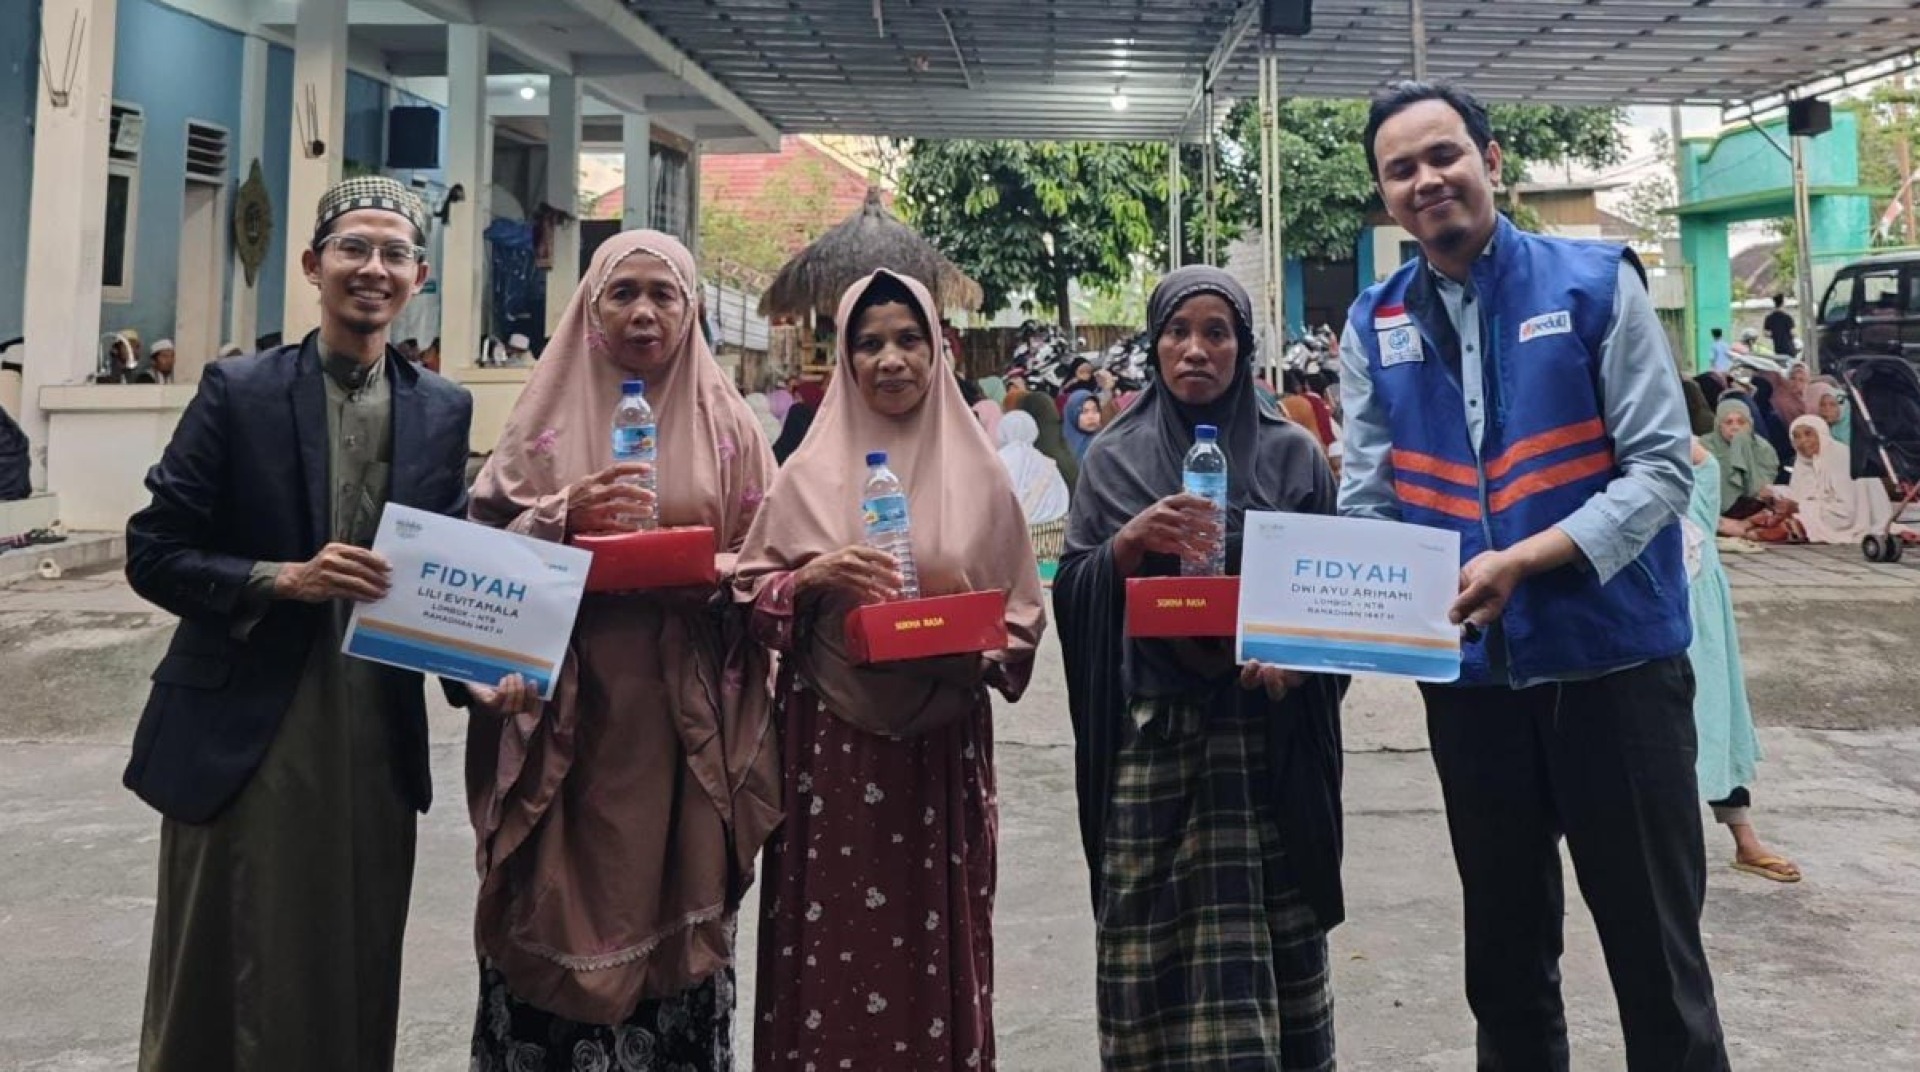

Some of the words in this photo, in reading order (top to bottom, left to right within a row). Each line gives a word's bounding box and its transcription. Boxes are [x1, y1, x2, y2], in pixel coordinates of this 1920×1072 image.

[1295, 559, 1408, 584] FIDYAH
[420, 562, 528, 602] FIDYAH
[1291, 583, 1316, 594] DWI
[1320, 585, 1349, 597] AYU
[417, 586, 442, 600] LILI
[444, 593, 519, 618] EVITAMALA
[431, 603, 468, 616] LOMBOK
[1314, 599, 1353, 607] LOMBOK
[422, 610, 474, 628] RAMADHAN
[1307, 606, 1362, 617] RAMADHAN
